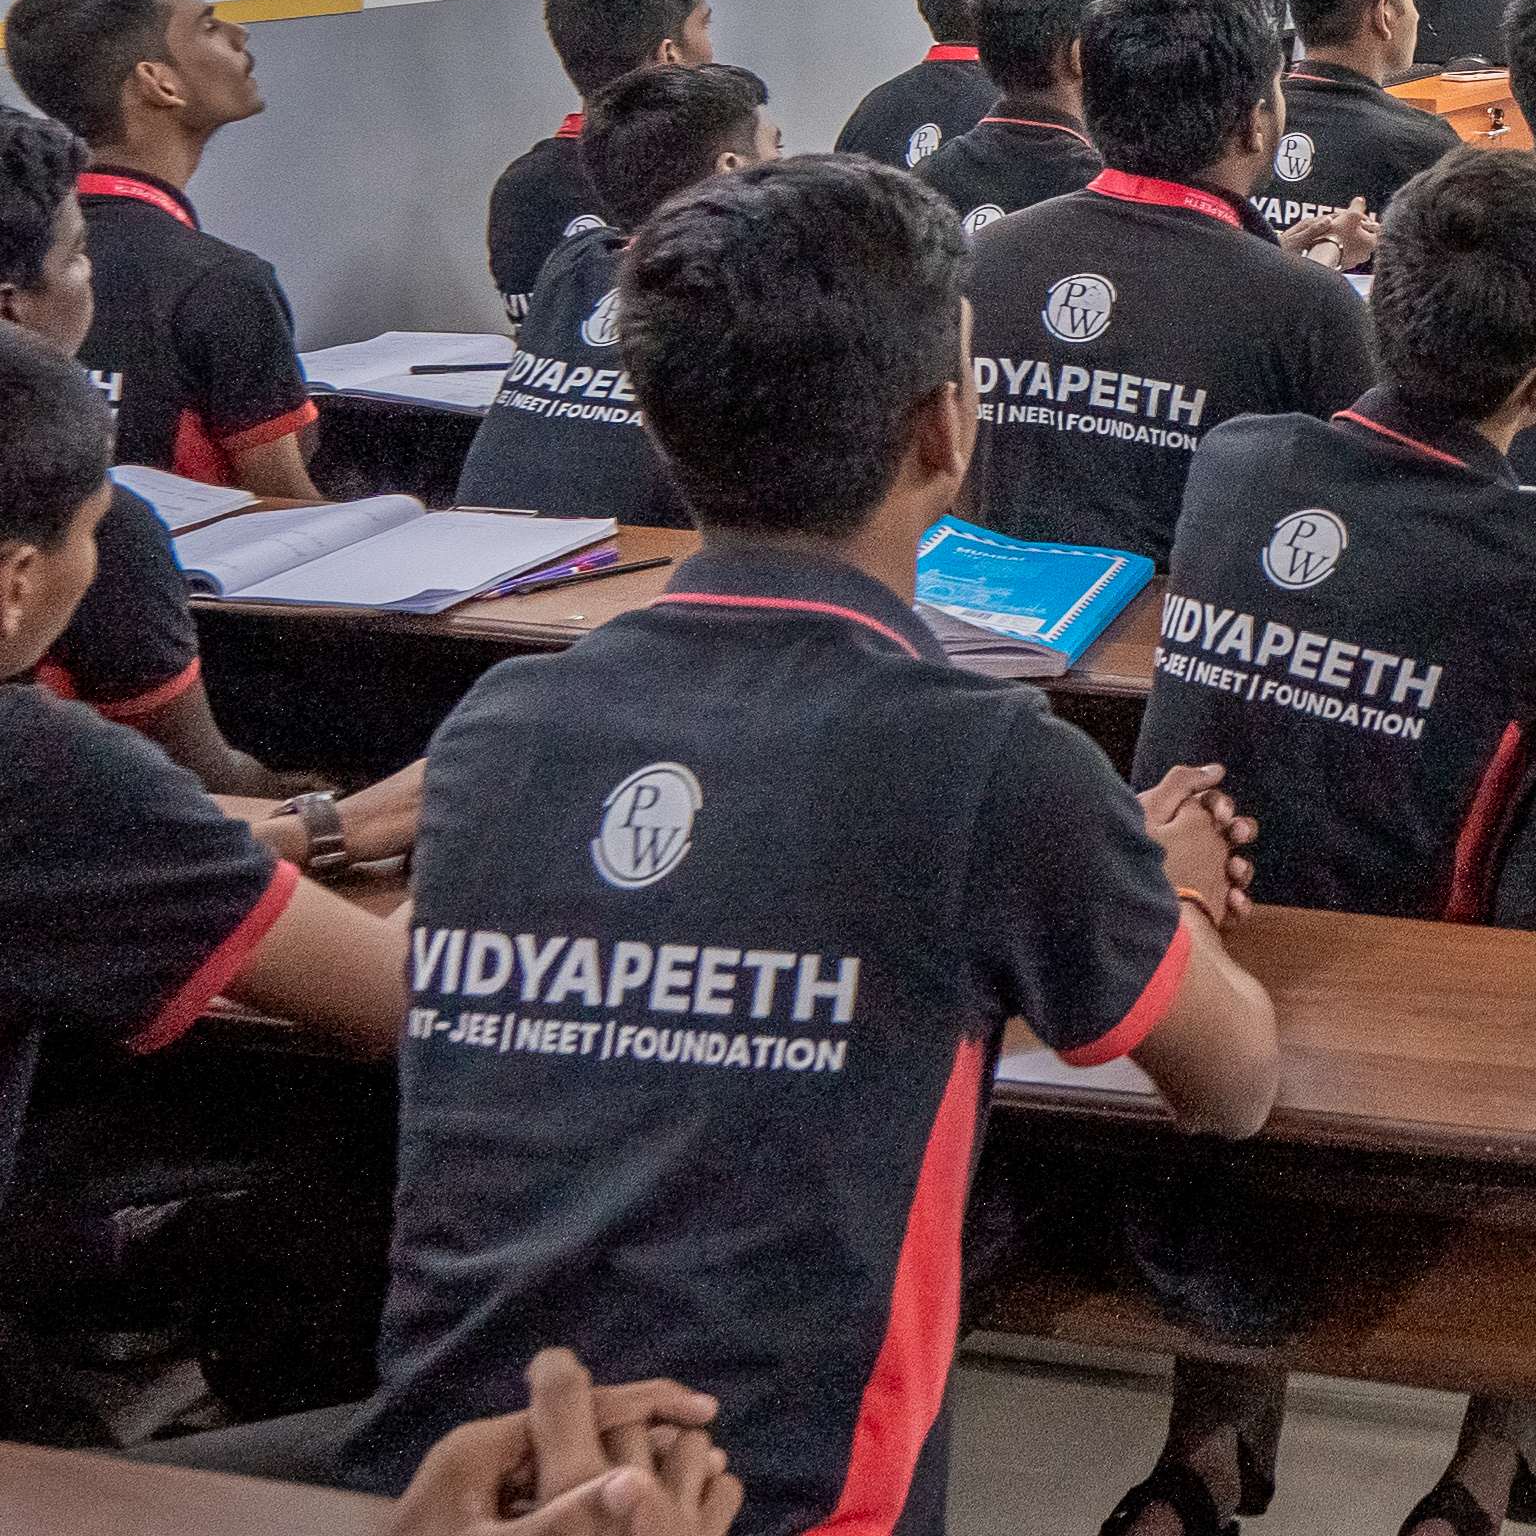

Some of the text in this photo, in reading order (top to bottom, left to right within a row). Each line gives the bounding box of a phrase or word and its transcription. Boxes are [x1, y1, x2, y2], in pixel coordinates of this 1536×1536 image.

[508, 350, 636, 401] DYAPEE
[974, 357, 1207, 427] DYAPEETH
[556, 403, 643, 427] FOUNDA
[1066, 413, 1198, 452] FOUNDATION
[1161, 593, 1443, 709] VIDYAPEETH
[1194, 662, 1248, 694] NEET
[1261, 680, 1425, 740] FOUNDATION
[412, 927, 862, 1024] VIDYAPEETH
[517, 1016, 601, 1057] NEET
[616, 1026, 847, 1072] FOUNDATION
